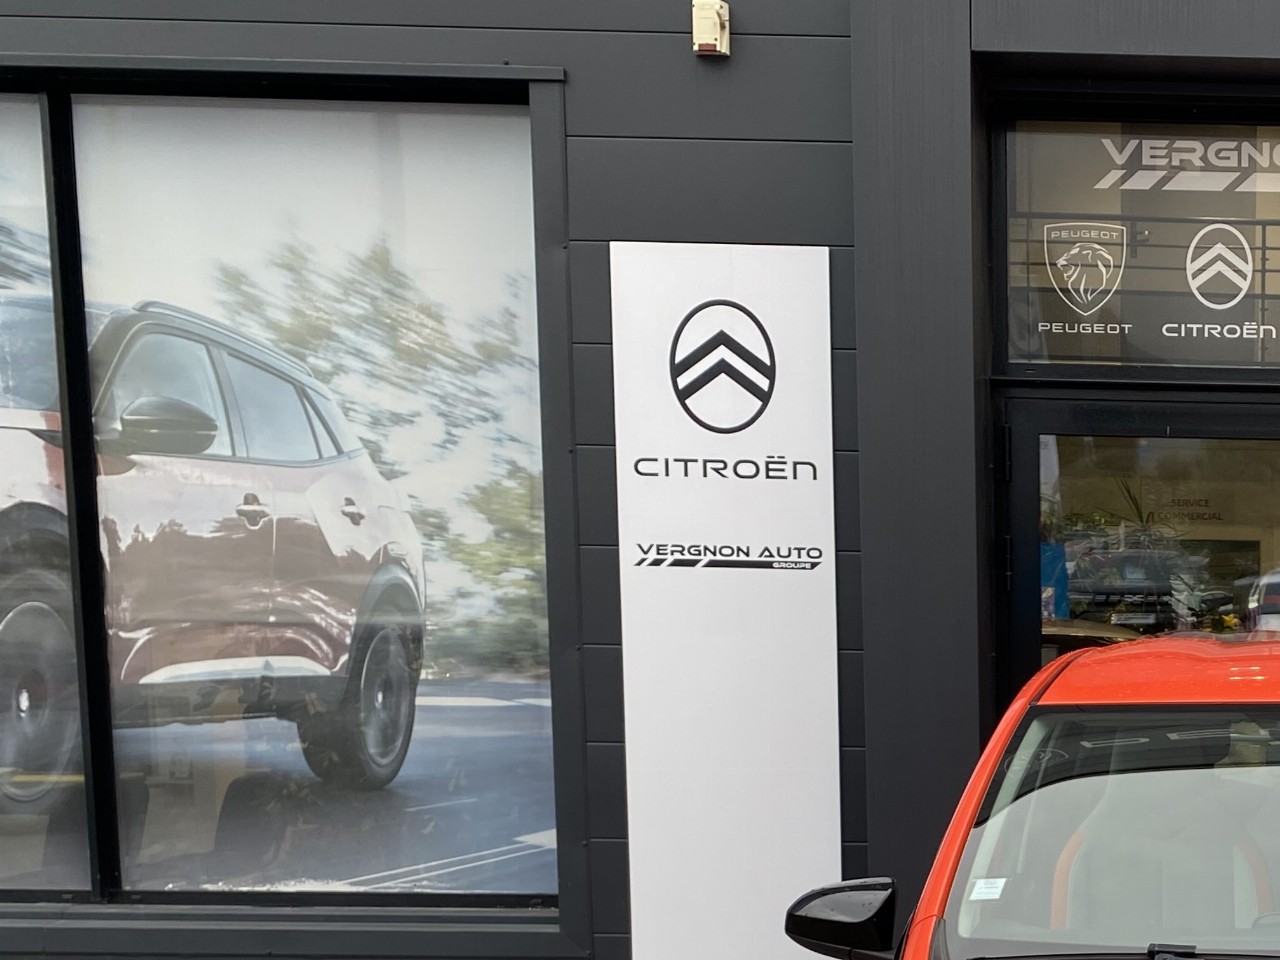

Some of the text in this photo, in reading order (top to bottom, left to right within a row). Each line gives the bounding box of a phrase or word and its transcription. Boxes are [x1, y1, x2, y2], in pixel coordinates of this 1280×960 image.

[1050, 230, 1120, 241] PEUGEOT
[1038, 322, 1133, 335] PEUGEOT
[1171, 498, 1209, 508] SERVICE
[1157, 511, 1223, 521] COMMERCIAL
[636, 543, 823, 560] VERGNON AUTO
[772, 561, 812, 569] GROUPE
